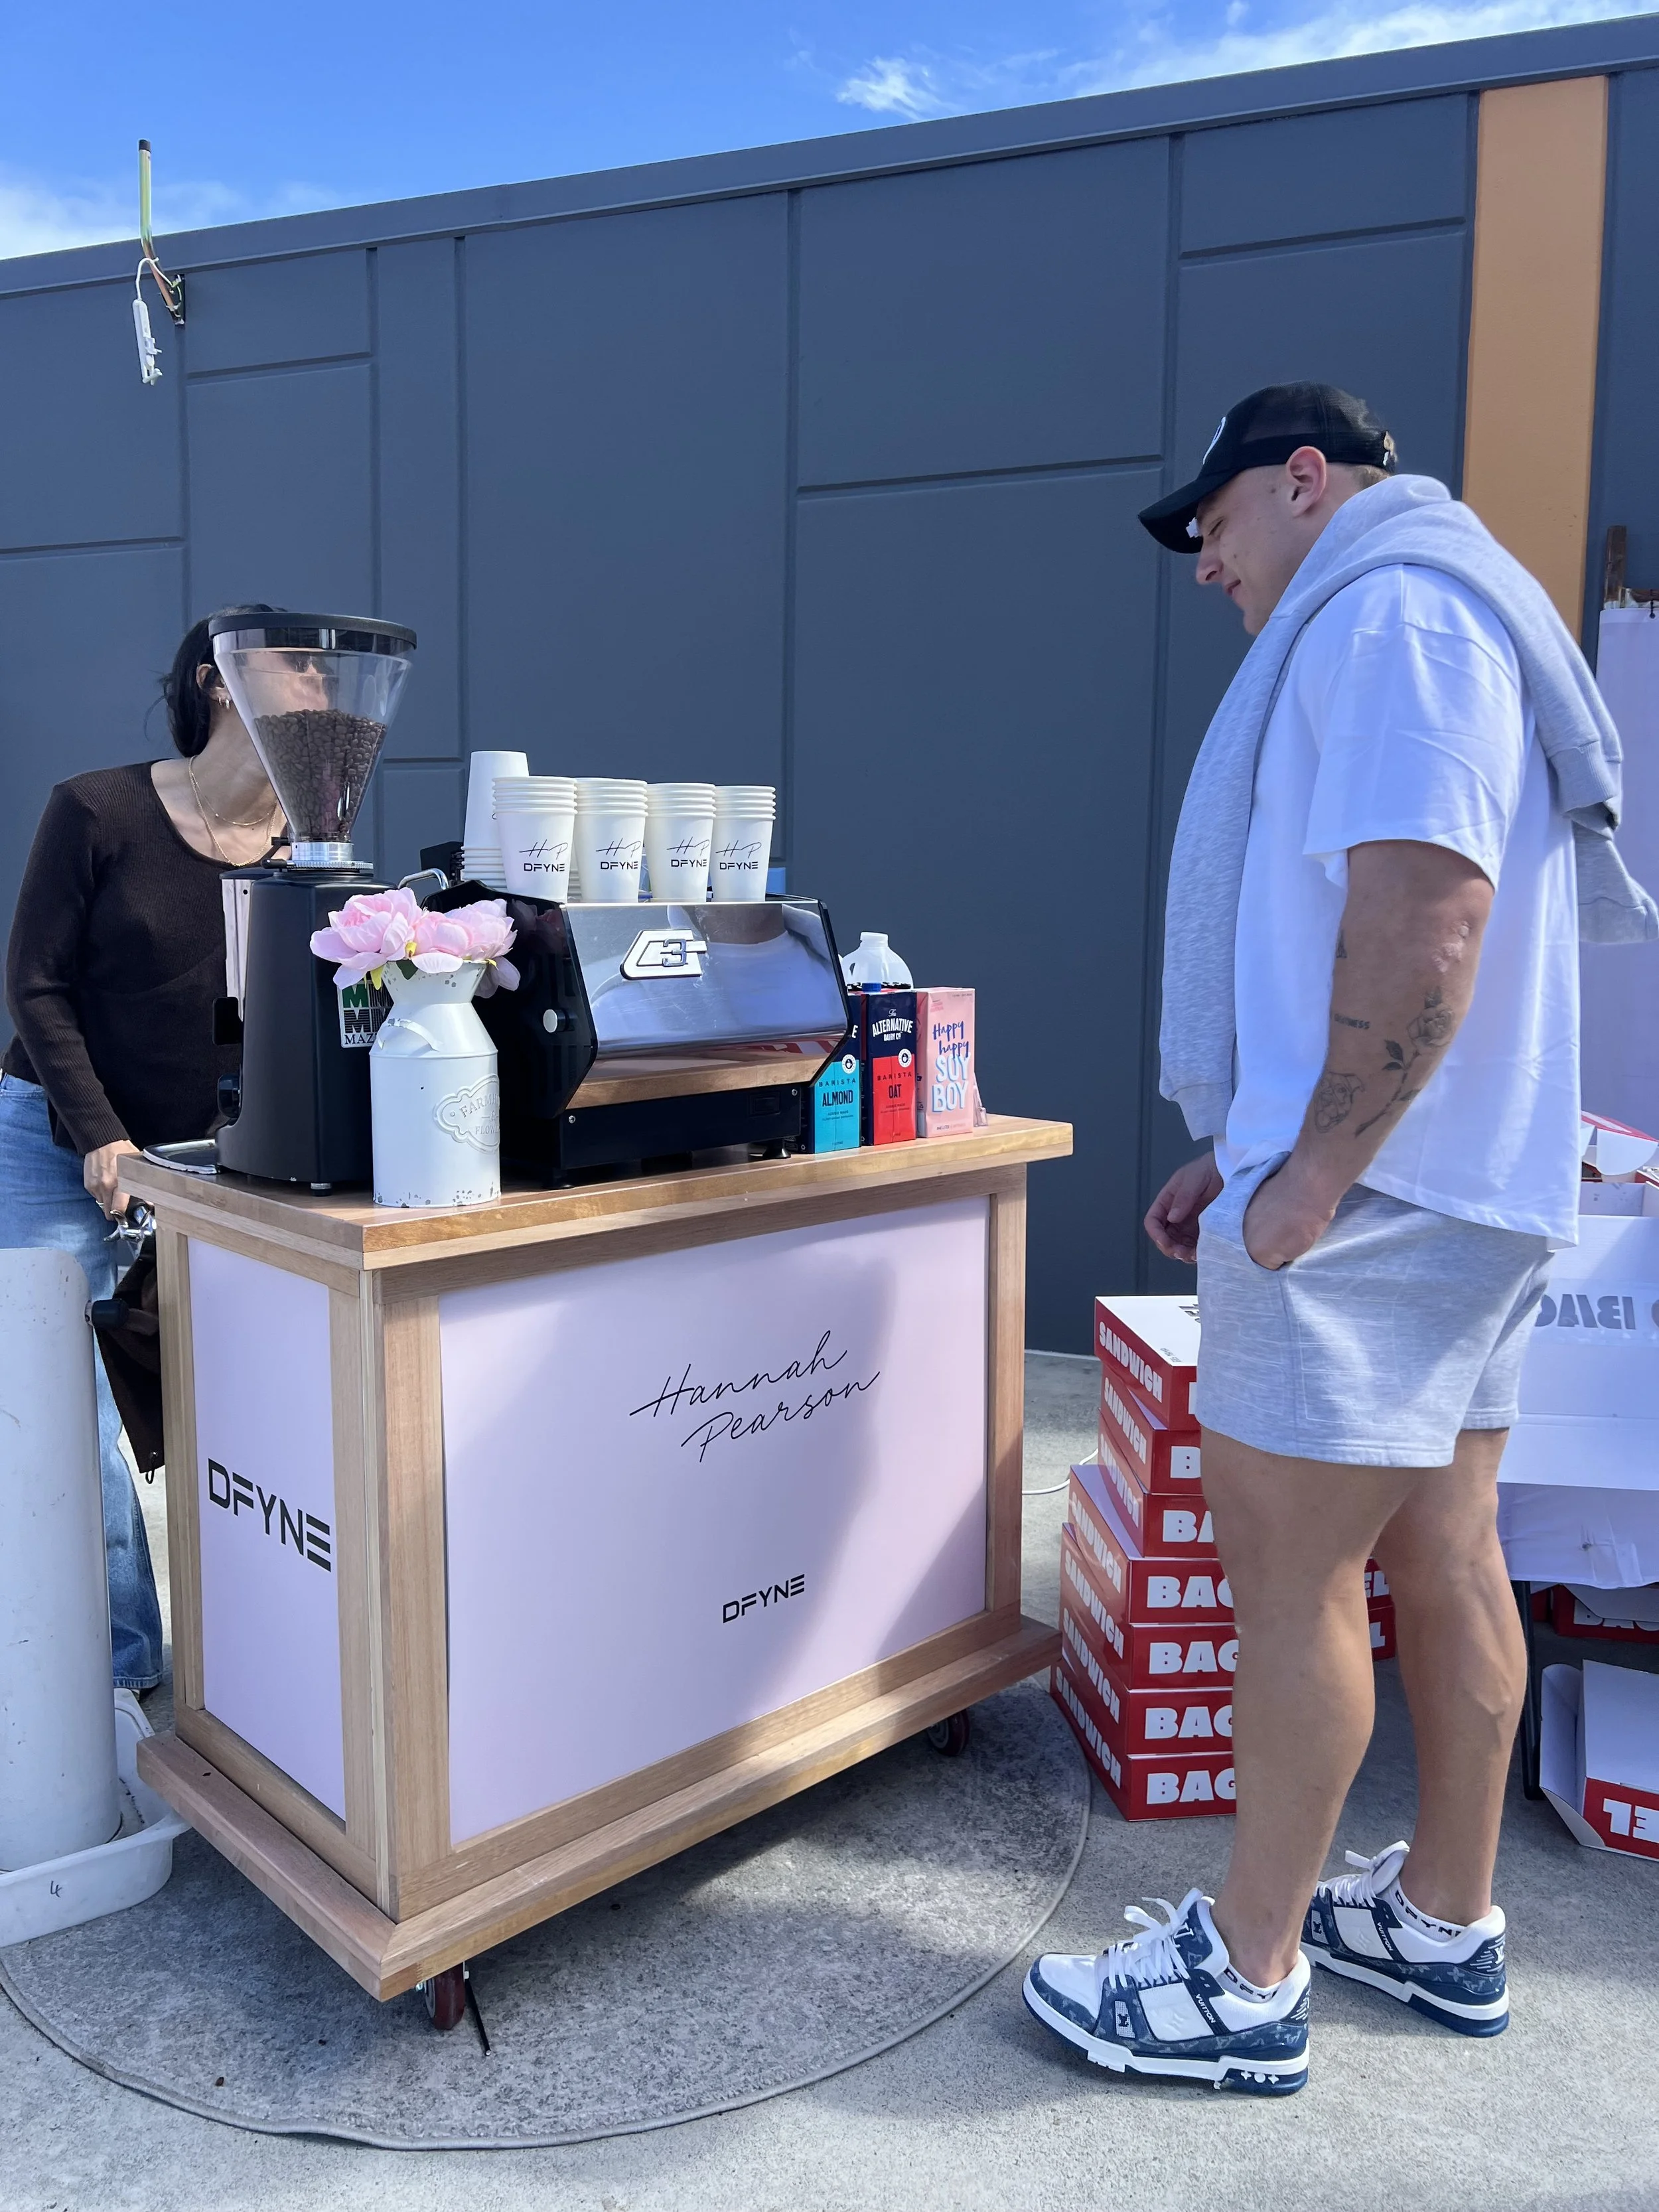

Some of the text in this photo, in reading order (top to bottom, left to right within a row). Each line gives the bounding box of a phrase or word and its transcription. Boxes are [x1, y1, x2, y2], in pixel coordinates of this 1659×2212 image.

[524, 863, 565, 872] DFYNE
[600, 861, 638, 870] DFYNE
[671, 859, 707, 867] DFYNE
[719, 861, 758, 870] DFYNE
[344, 1033, 377, 1045] MAZ
[872, 1018, 914, 1037] ALTERNATIVE
[818, 1078, 856, 1087] BARISTA
[877, 1072, 912, 1080] BARISTA
[936, 1053, 971, 1082] SOY
[822, 1090, 853, 1107] ALMOND
[889, 1084, 902, 1098] OAT
[932, 1080, 969, 1112] BOY
[629, 1330, 847, 1418] Hannah
[1099, 1321, 1162, 1403] SANDWICH
[681, 1370, 881, 1462] Pearson
[1104, 1377, 1147, 1465] SANDWICH
[1100, 1434, 1139, 1528] SANDWICH
[208, 1457, 331, 1572] DFYNE
[1072, 1492, 1121, 1593] SANDWICH
[723, 1574, 805, 1624] DFYNE
[1065, 1550, 1124, 1659] SANDWICH
[1063, 1607, 1120, 1724] SANDWICH
[1056, 1666, 1121, 1789] SANDWICH
[1377, 1922, 1394, 1951] VUITTON
[1196, 1993, 1216, 2024] VUITTON
